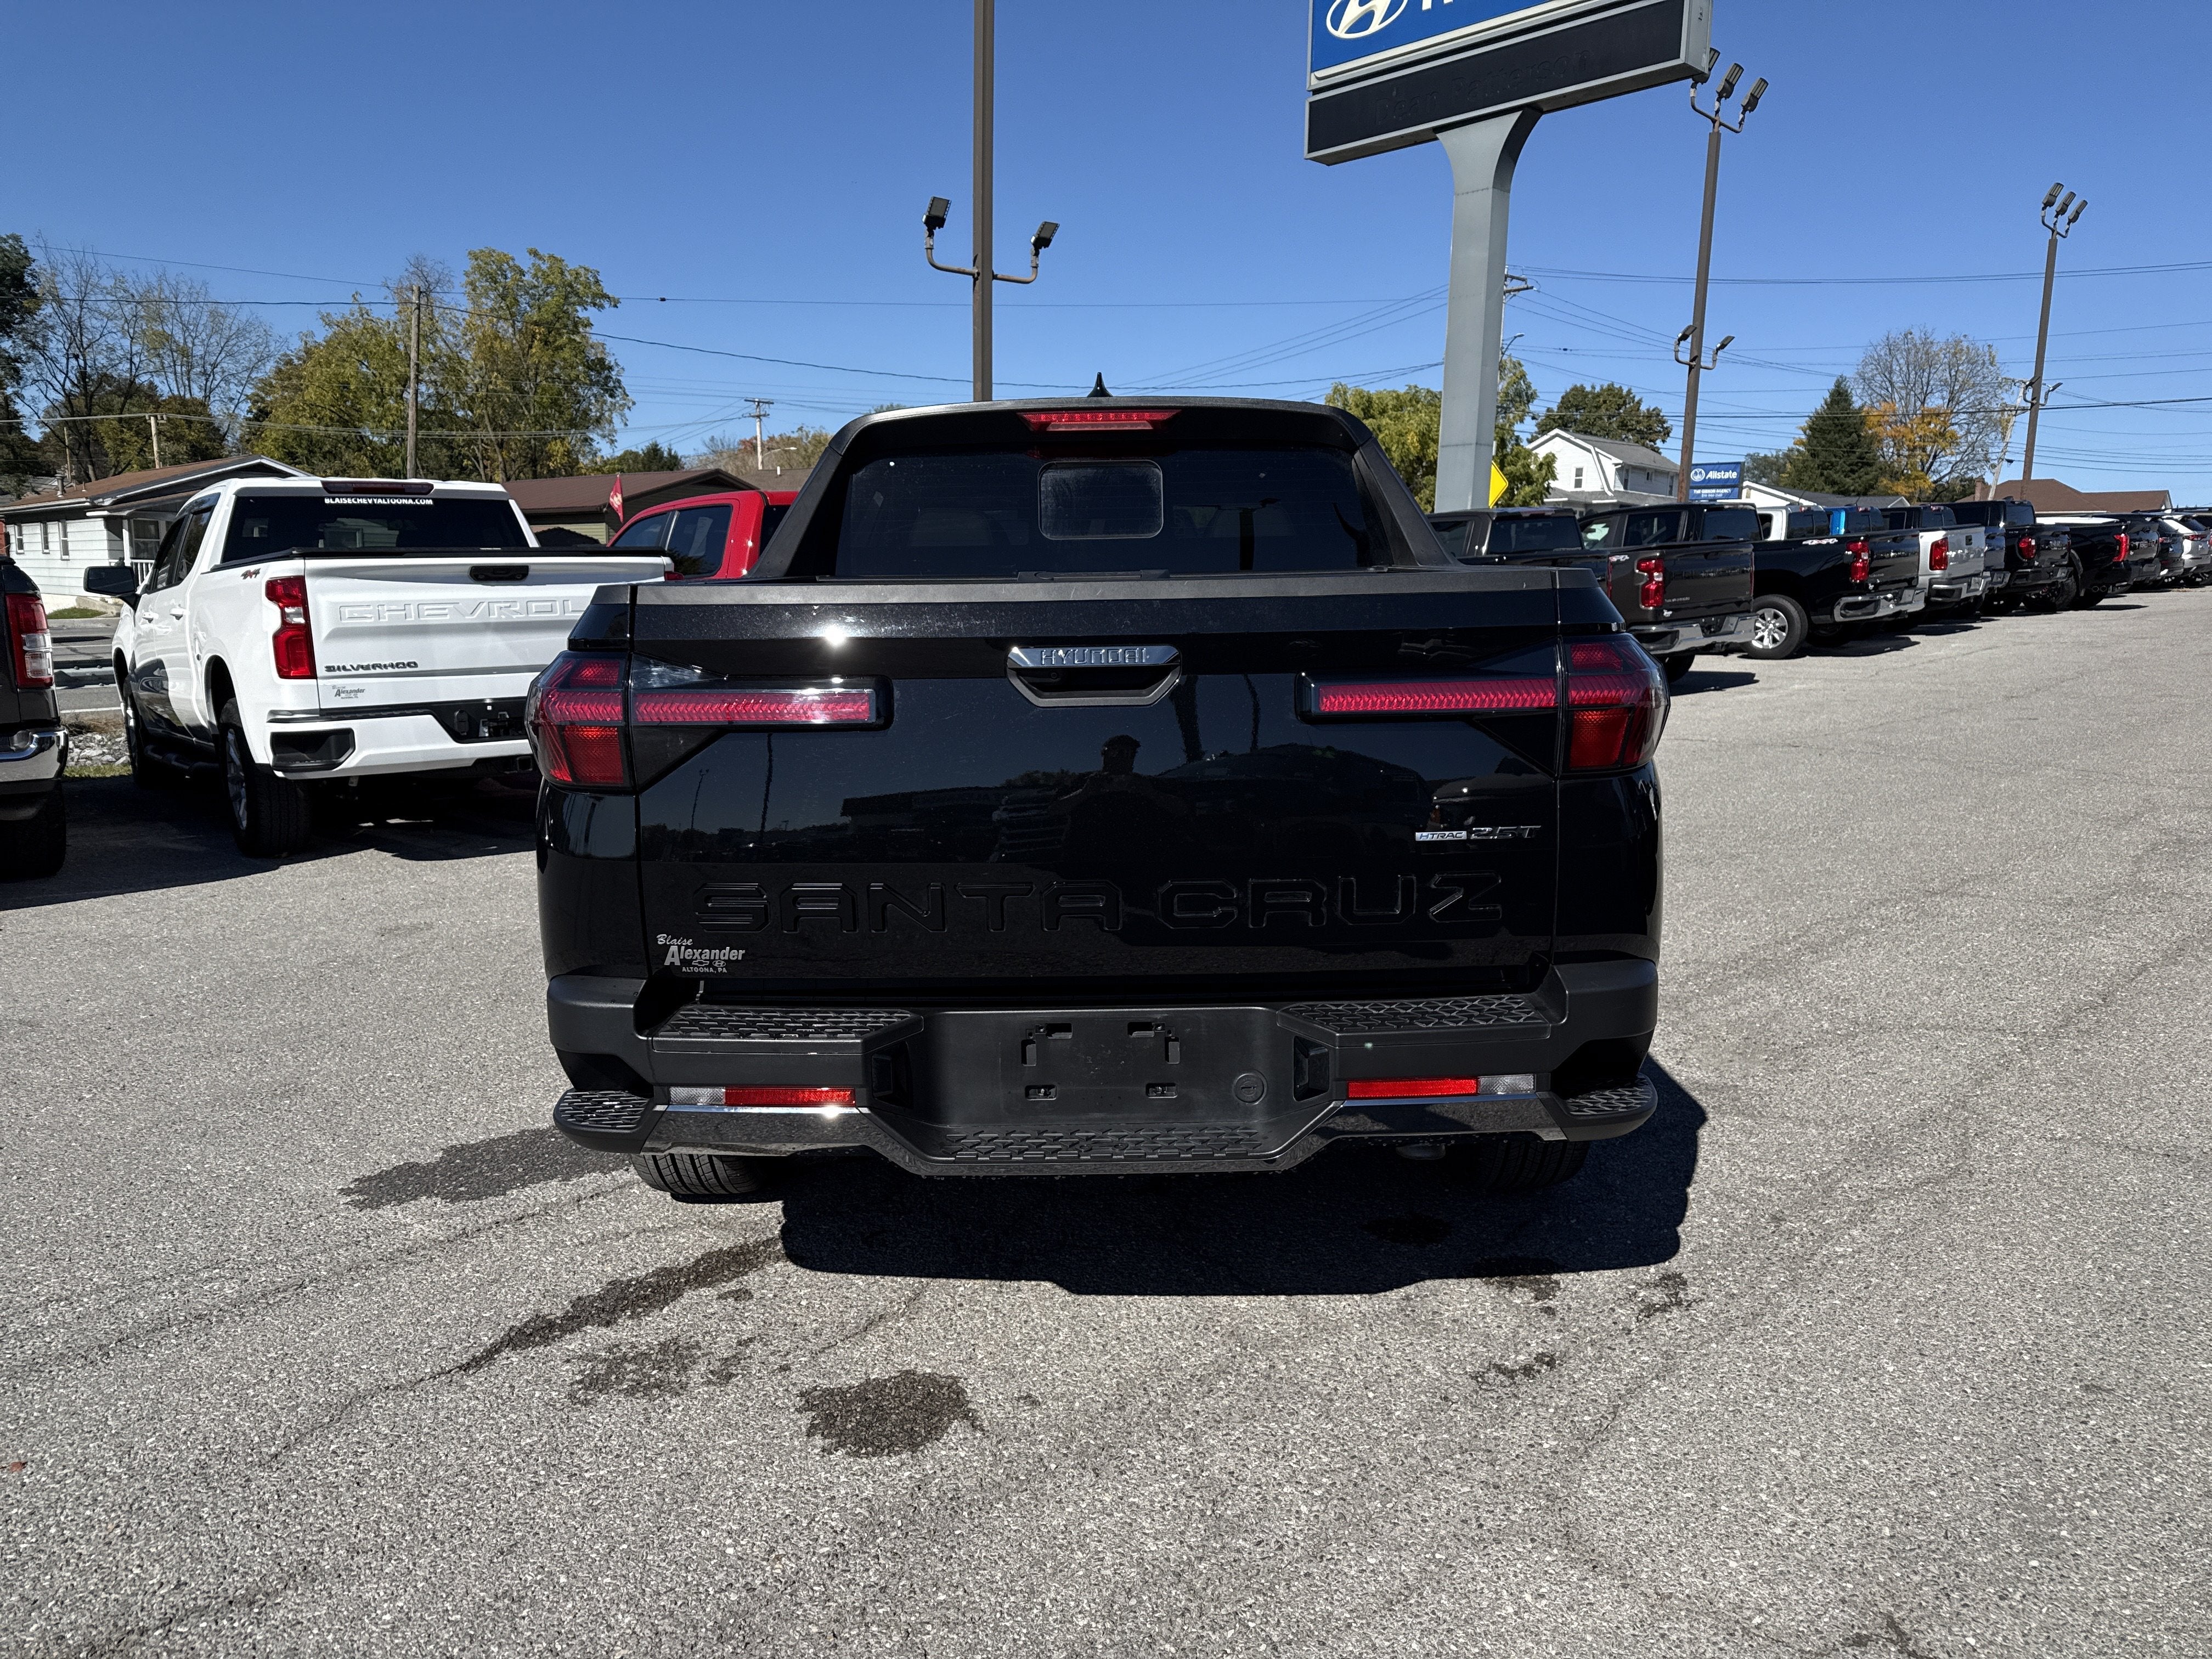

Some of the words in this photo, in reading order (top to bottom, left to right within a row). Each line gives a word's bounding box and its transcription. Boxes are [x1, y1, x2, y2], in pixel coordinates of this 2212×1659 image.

[1706, 470, 1737, 479] Allstate
[339, 599, 585, 623] CHEVROL
[1041, 647, 1147, 665] HYUNDAI
[324, 661, 419, 673] SILVERADO
[334, 688, 365, 697] Alexander
[1419, 832, 1464, 840] HTRAC
[1470, 825, 1542, 840] 2.5T
[692, 882, 1123, 933] SANTA
[1157, 871, 1503, 929] CRUZ
[656, 934, 693, 945] Blaise
[664, 945, 746, 966] Alexander
